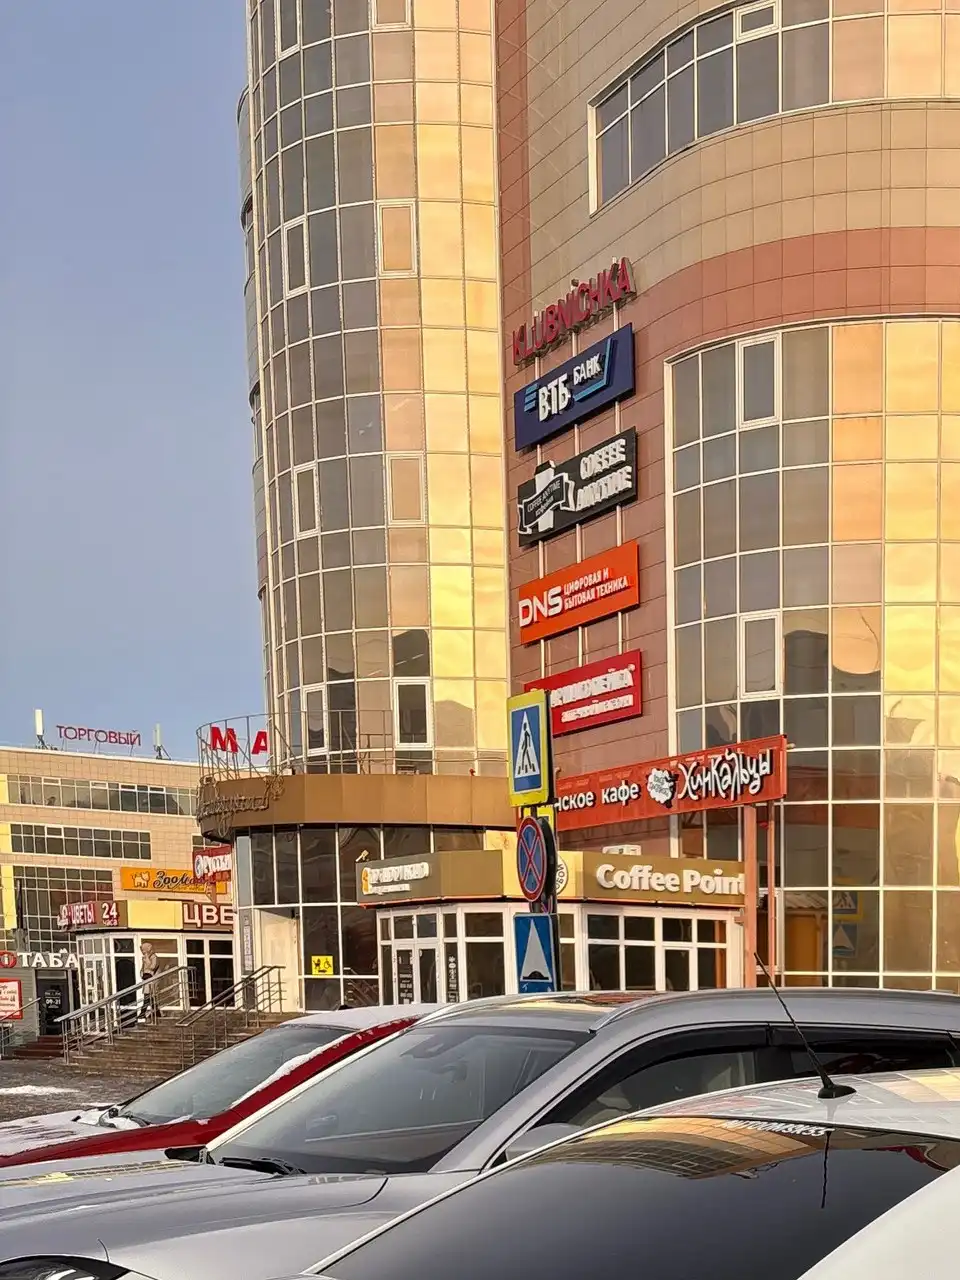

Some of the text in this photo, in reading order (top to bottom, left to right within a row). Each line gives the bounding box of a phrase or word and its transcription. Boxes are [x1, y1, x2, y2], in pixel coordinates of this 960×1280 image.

[512, 256, 637, 366] KLUBNICHKA
[538, 352, 602, 423] ВТБ БАНК
[563, 567, 609, 596] ЦИФРОВАЯ И
[564, 575, 628, 610] БЫТОВАЯ ТЕХНИКА
[518, 585, 563, 628] DNS
[56, 725, 142, 746] ТОРГОВЫЙ
[601, 779, 640, 807] кафе
[596, 863, 745, 895] Coffee Point
[71, 903, 95, 924] ЦВЕТЫ
[102, 902, 118, 919] 24
[183, 903, 234, 928] ЦВЕ
